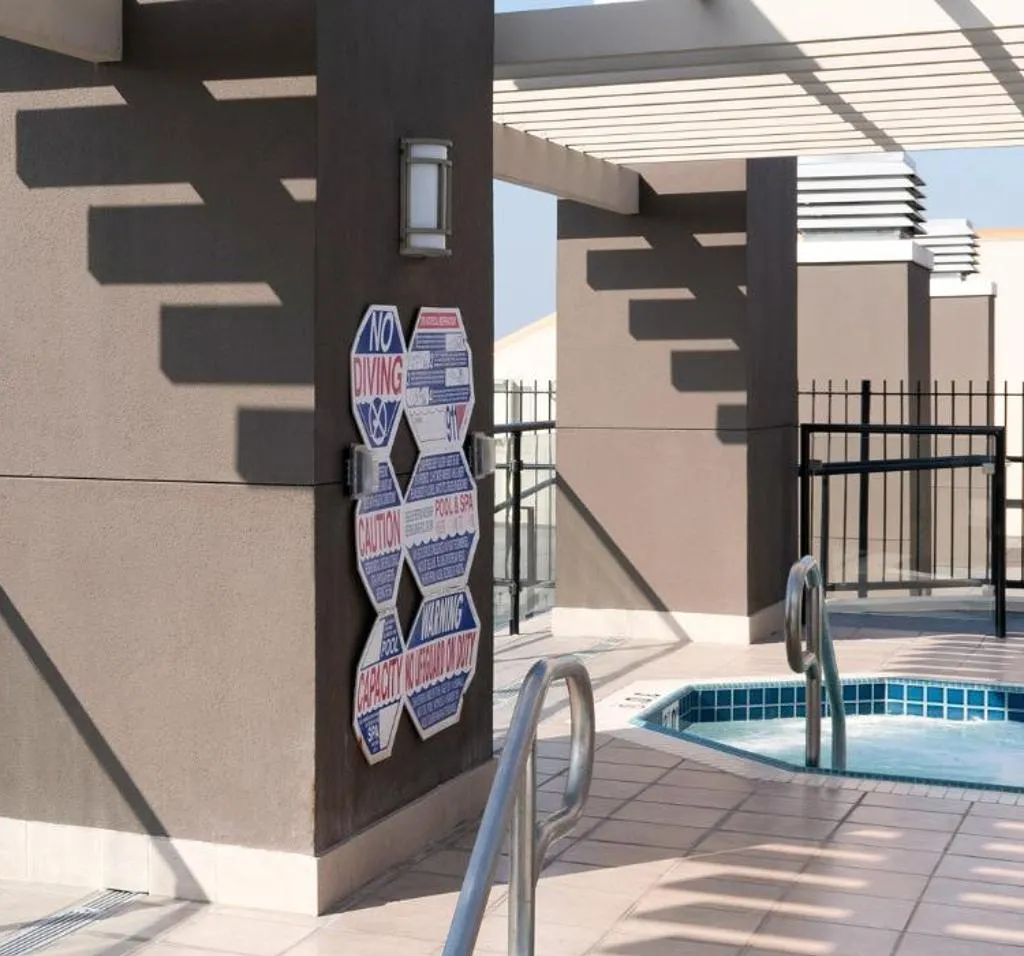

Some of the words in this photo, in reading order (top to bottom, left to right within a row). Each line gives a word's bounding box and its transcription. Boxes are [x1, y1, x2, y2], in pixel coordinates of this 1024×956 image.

[369, 311, 394, 352] NO
[355, 355, 403, 397] DIVING
[445, 405, 460, 442] 911
[436, 497, 454, 517] POOL
[460, 493, 474, 514] SPA
[358, 511, 401, 556] CAUTION
[421, 594, 464, 641] WARNING
[383, 635, 399, 656] POOL
[457, 630, 476, 672] DUTY
[358, 656, 403, 714] CAPACITY
[367, 722, 379, 743] SPA
